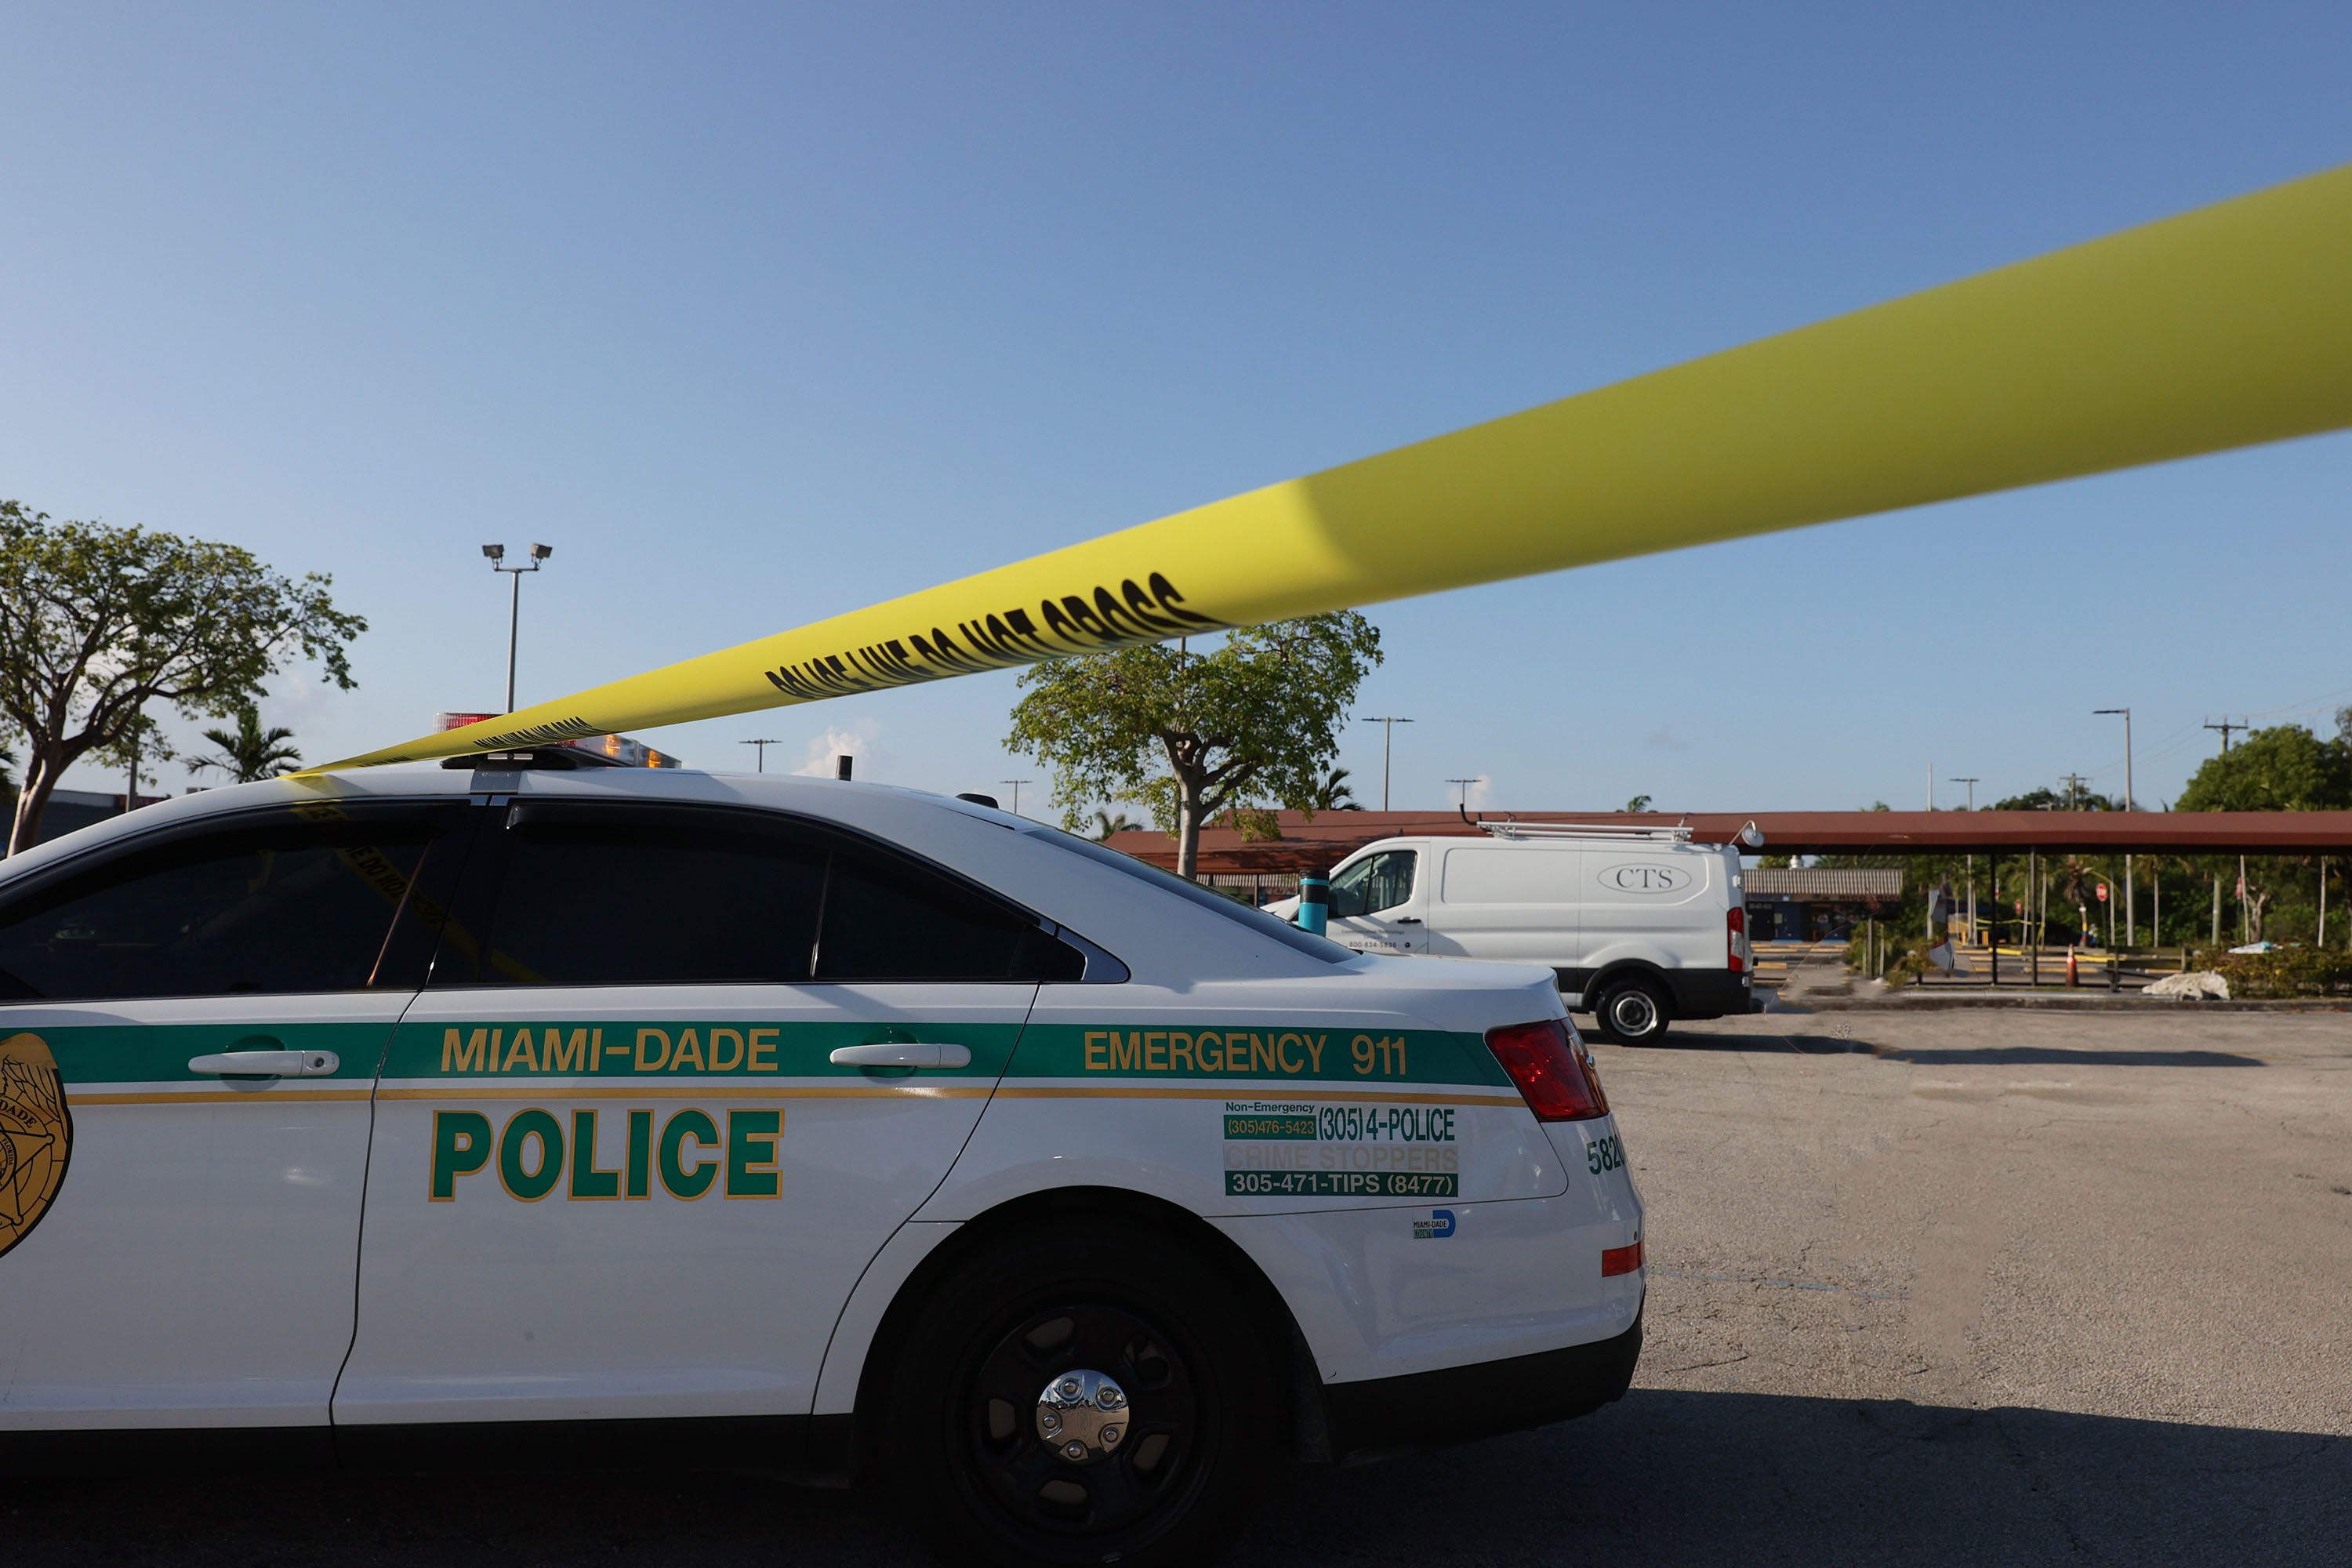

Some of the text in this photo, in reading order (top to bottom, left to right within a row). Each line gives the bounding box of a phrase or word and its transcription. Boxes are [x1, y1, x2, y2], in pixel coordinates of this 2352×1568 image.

[1616, 868, 1672, 888] CTS
[441, 1029, 780, 1072] MIAMI-DADE
[1084, 1031, 1406, 1075] EMERGENCY 911
[1225, 1102, 1315, 1114] Non-Emergency
[1229, 1119, 1314, 1134] (305)476-5423
[428, 1108, 785, 1203] POLICE
[1225, 1145, 1458, 1172] CRIME STOPPERS
[1232, 1174, 1453, 1195] 305-471-TIPS (8477)
